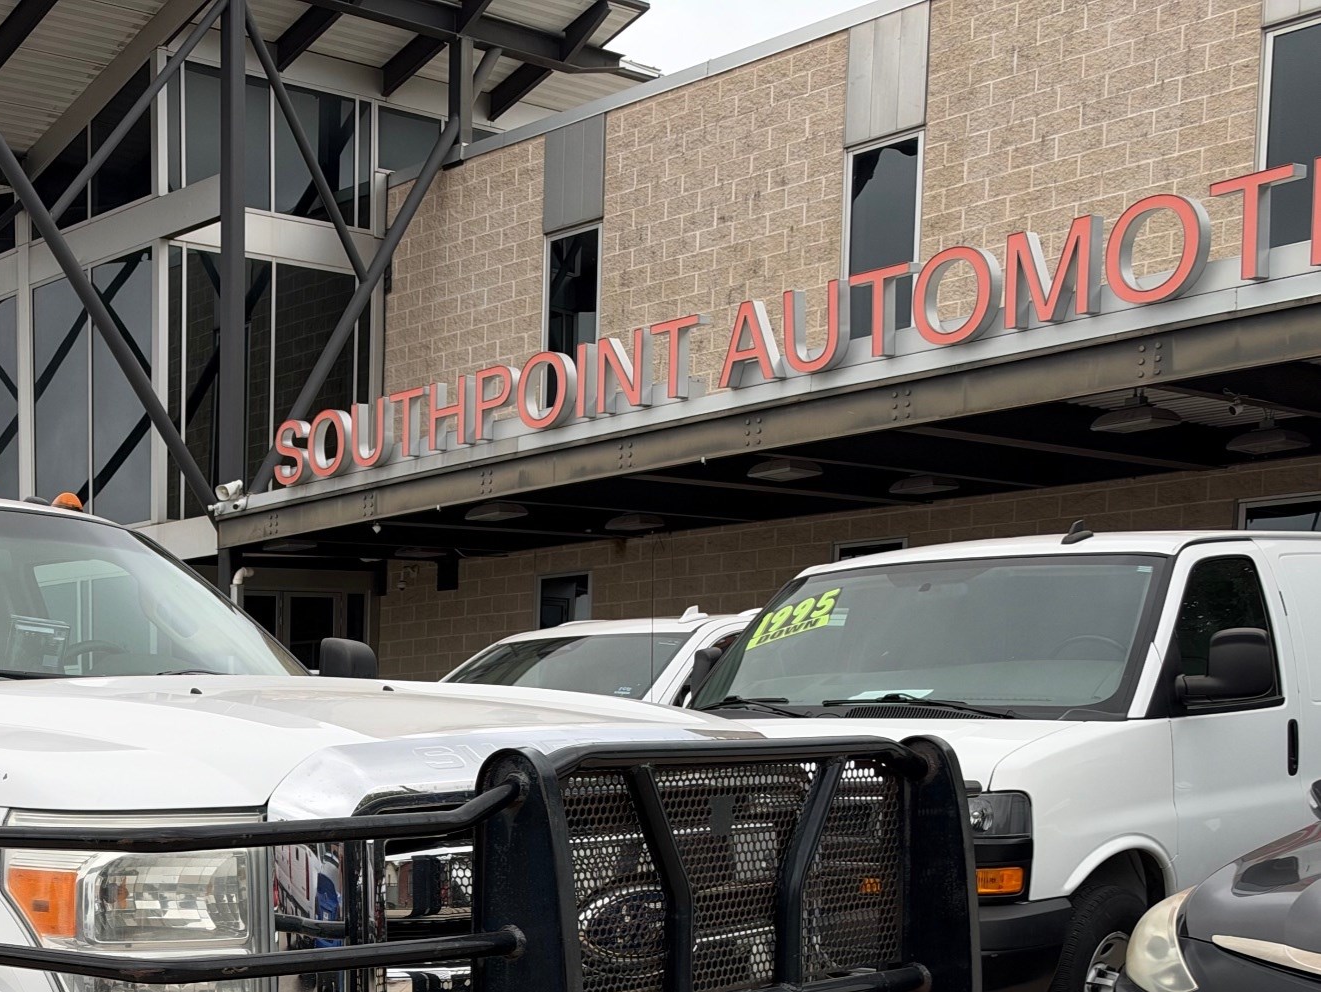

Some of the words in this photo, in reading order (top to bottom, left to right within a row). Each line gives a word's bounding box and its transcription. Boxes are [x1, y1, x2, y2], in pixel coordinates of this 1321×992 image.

[274, 314, 702, 486] SOUTHPOINT
[752, 587, 841, 639] 1995
[756, 616, 819, 646] DOWN
